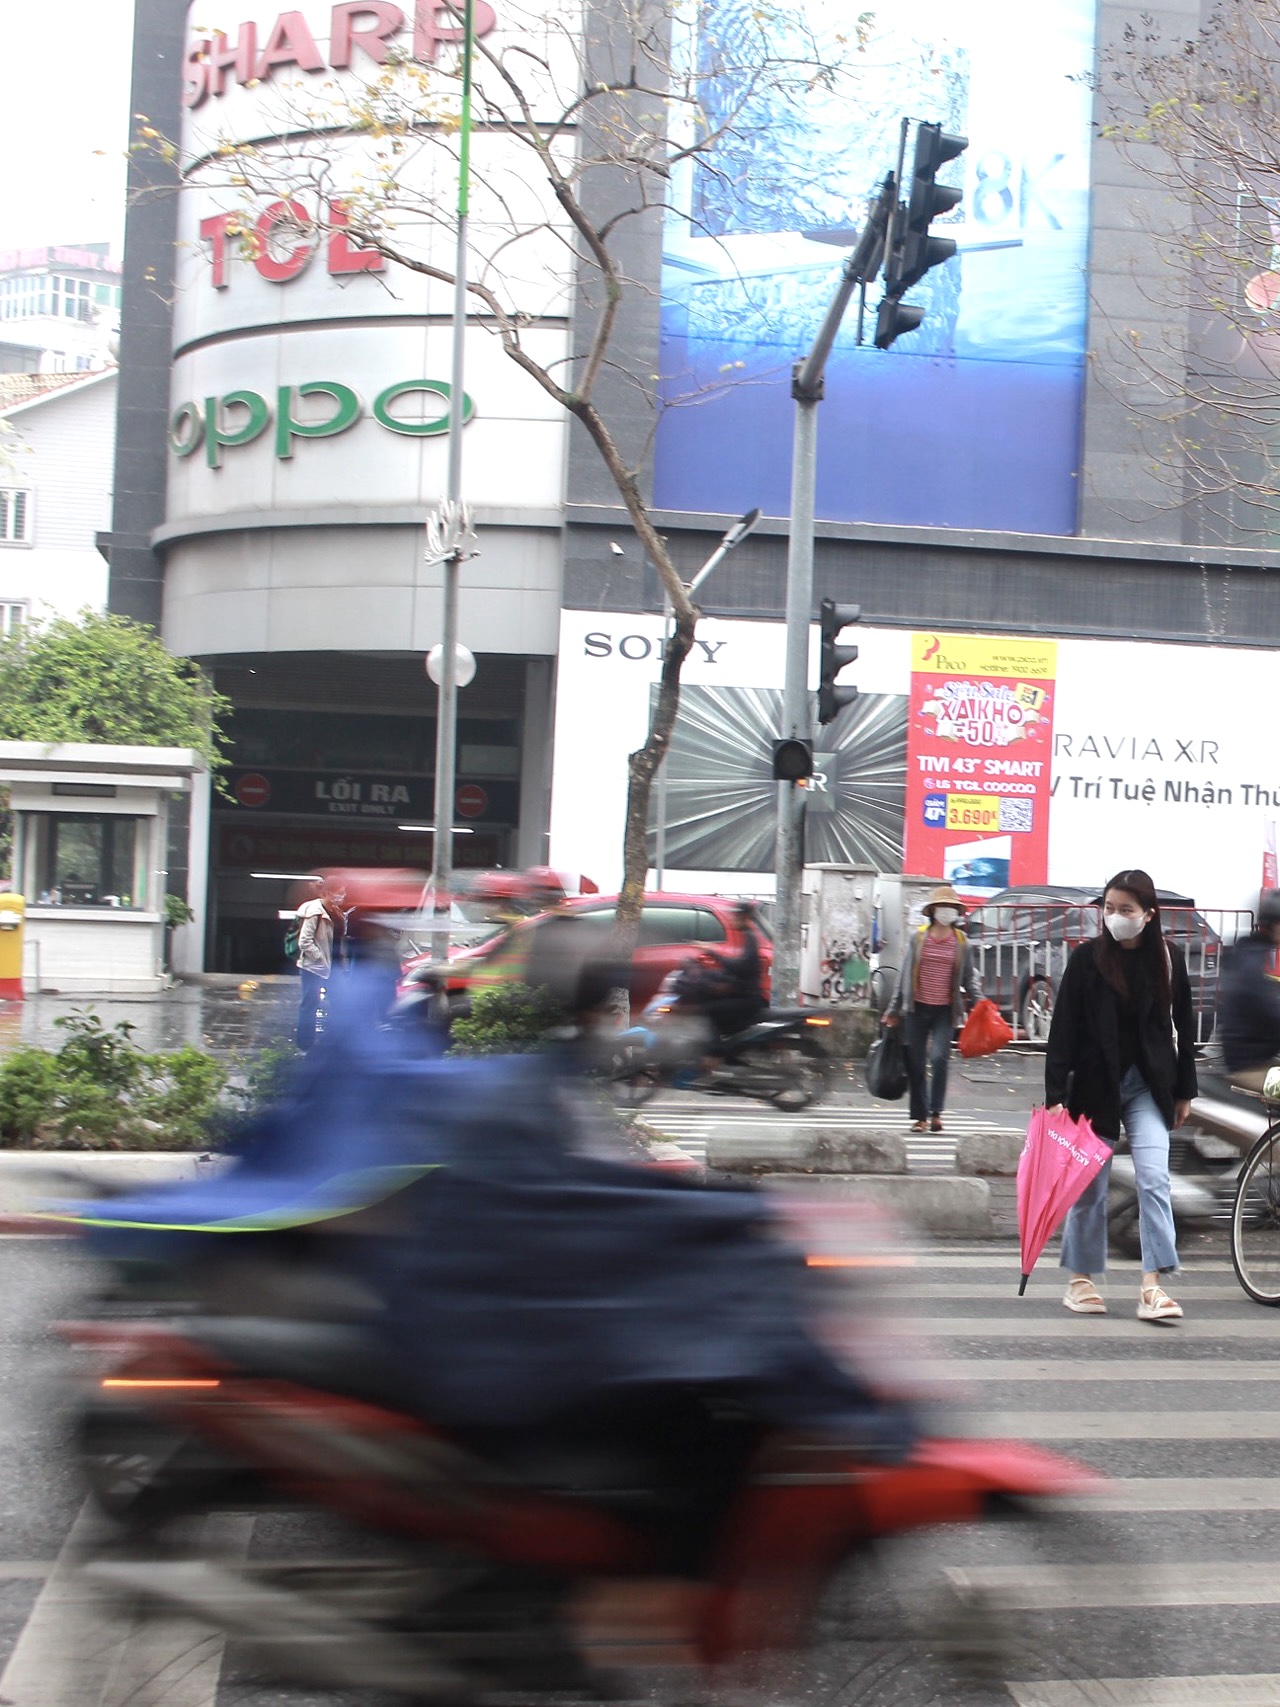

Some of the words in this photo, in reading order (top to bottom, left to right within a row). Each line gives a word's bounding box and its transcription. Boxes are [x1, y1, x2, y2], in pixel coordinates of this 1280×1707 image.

[182, 0, 496, 109] SHARP
[972, 152, 1066, 230] 8K
[200, 199, 387, 290] TCL
[584, 632, 727, 663] SOY
[1055, 734, 1164, 762] RAVIA
[1174, 739, 1219, 764] XR
[917, 755, 949, 773] TIVI
[984, 760, 1043, 777] SMART
[370, 783, 410, 803] RA
[936, 779, 951, 788] LG
[953, 780, 983, 791] TCL
[1069, 776, 1103, 799] Trí
[1109, 778, 1156, 806] Tuệ
[1164, 780, 1232, 809] Nhận
[328, 802, 358, 813] EXIT
[361, 804, 397, 815] ONLY
